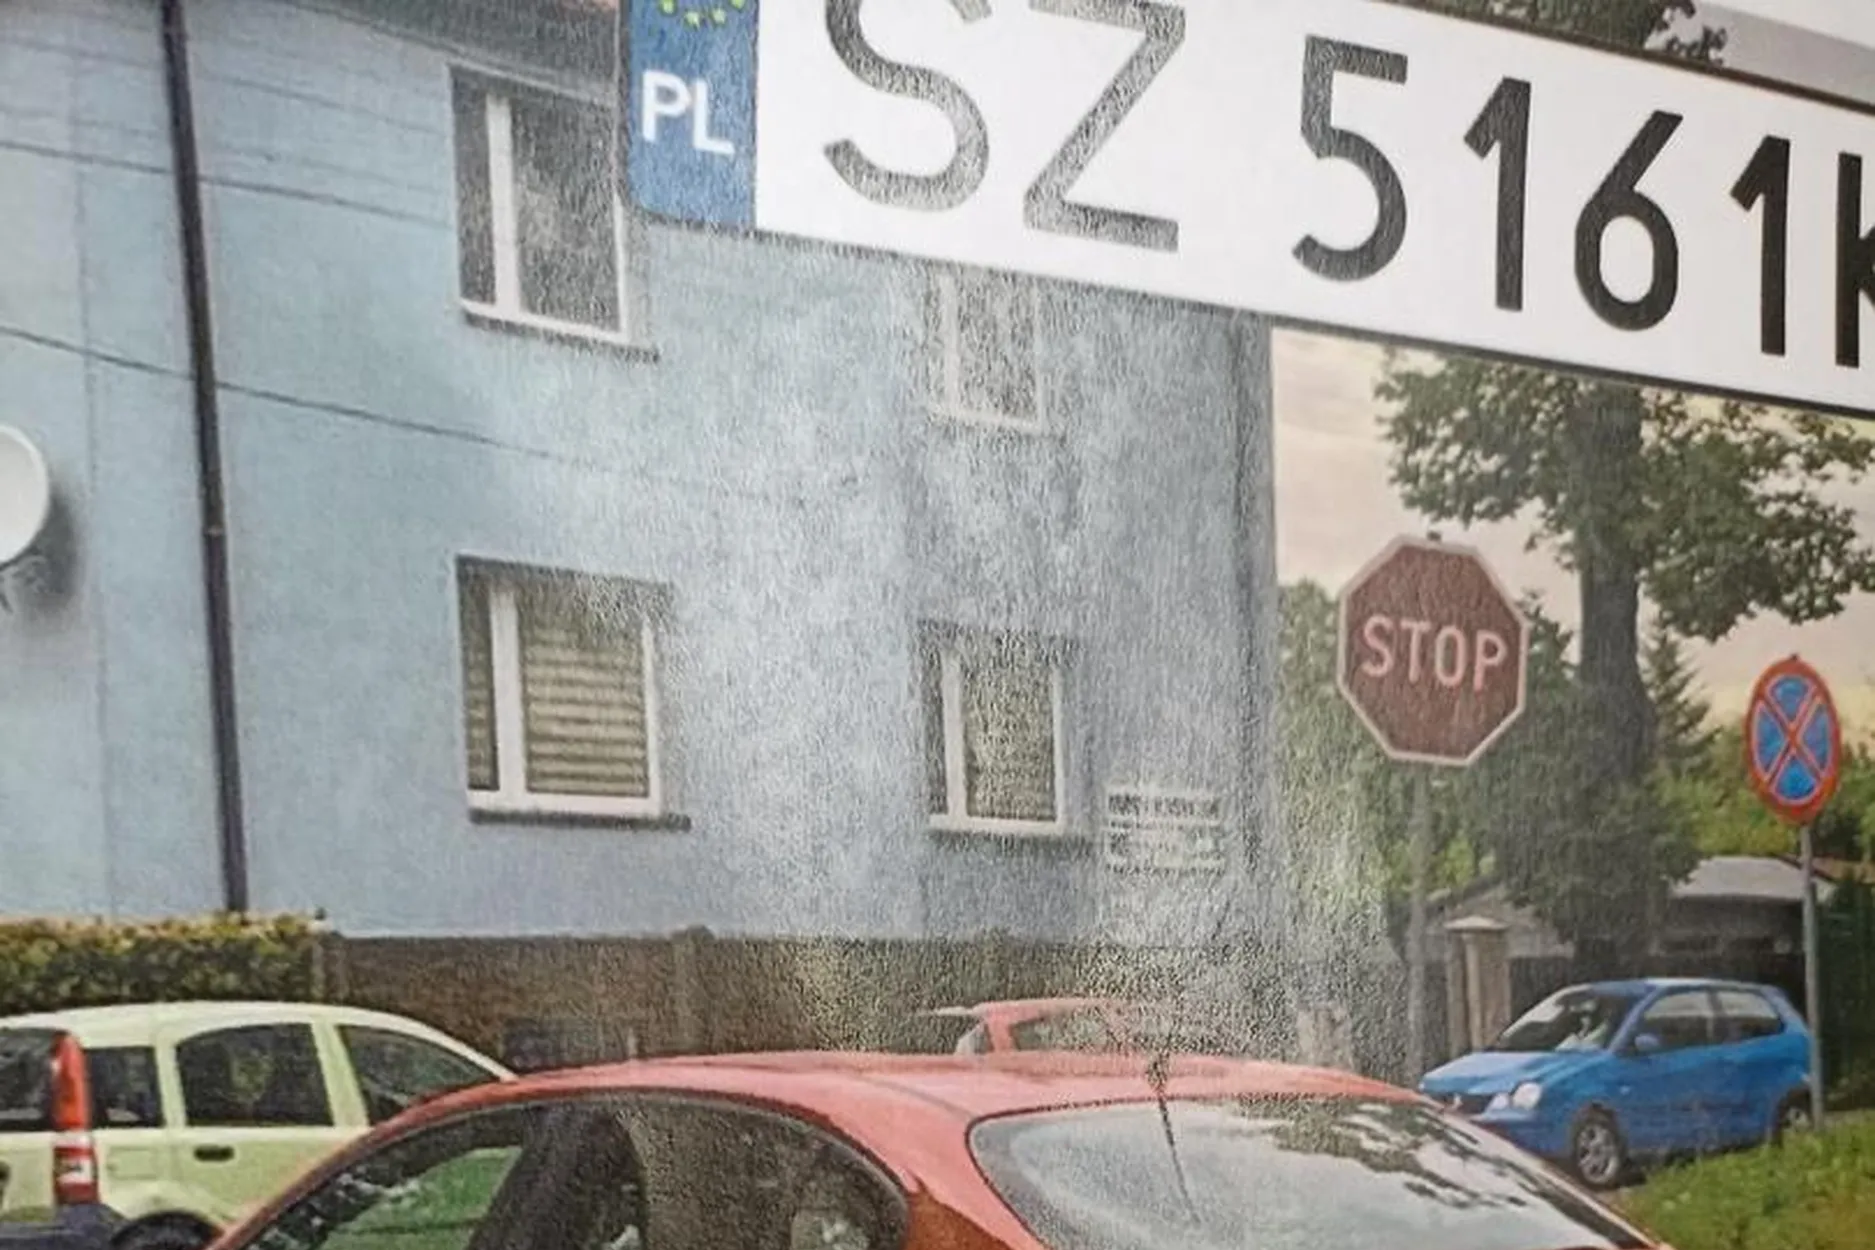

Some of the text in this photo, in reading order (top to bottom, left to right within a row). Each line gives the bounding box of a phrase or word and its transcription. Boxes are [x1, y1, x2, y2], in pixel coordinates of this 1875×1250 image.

[640, 69, 735, 156] PL
[824, 0, 1186, 253] SZ
[1361, 614, 1507, 691] STOP
